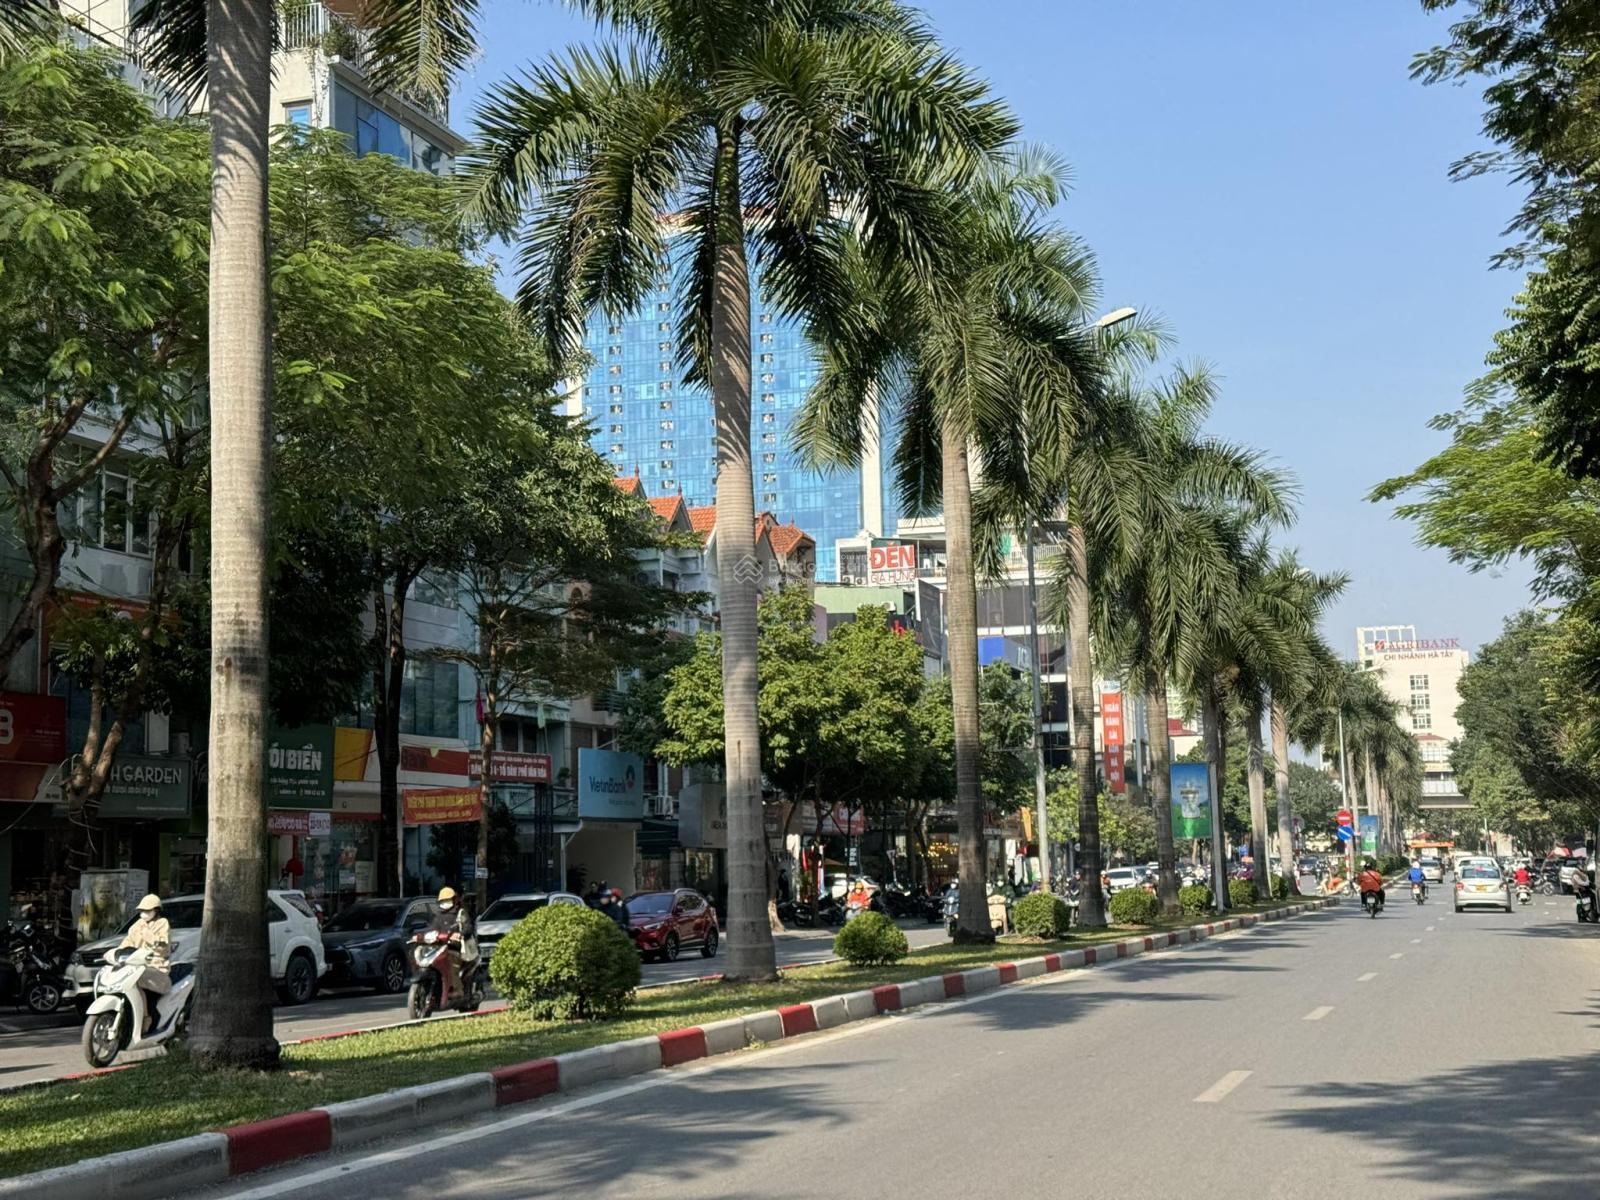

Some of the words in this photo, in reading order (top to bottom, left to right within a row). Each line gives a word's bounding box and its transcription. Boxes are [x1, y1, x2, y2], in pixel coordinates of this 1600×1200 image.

[1389, 638, 1460, 649] AGRIBANK
[1383, 652, 1396, 661] CHI
[122, 765, 182, 784] GARDEN
[589, 776, 626, 793] VietinBank
